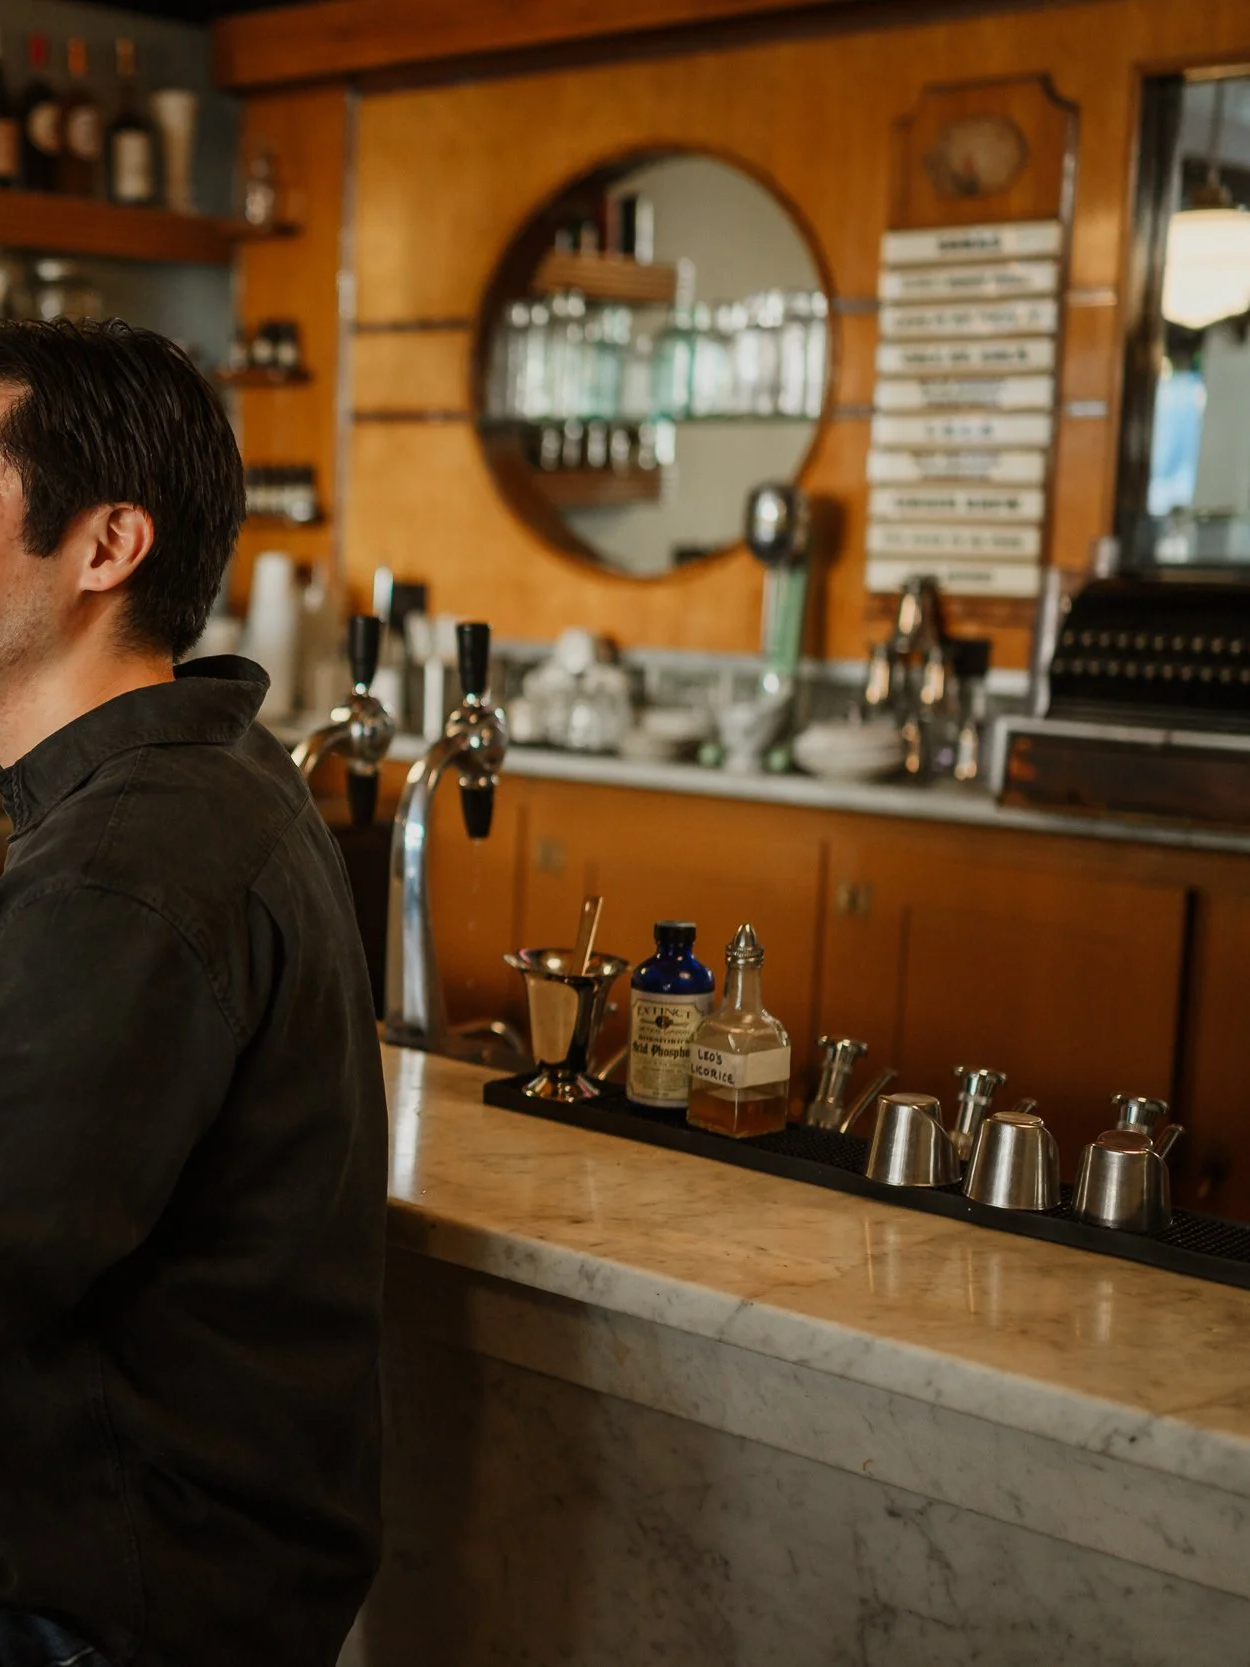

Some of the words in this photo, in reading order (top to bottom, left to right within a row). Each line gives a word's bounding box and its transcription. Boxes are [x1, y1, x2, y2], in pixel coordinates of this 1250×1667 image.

[637, 1005, 691, 1019] EXTINCT
[697, 1048, 722, 1065] LEO'S
[691, 1063, 734, 1085] LICORICE
